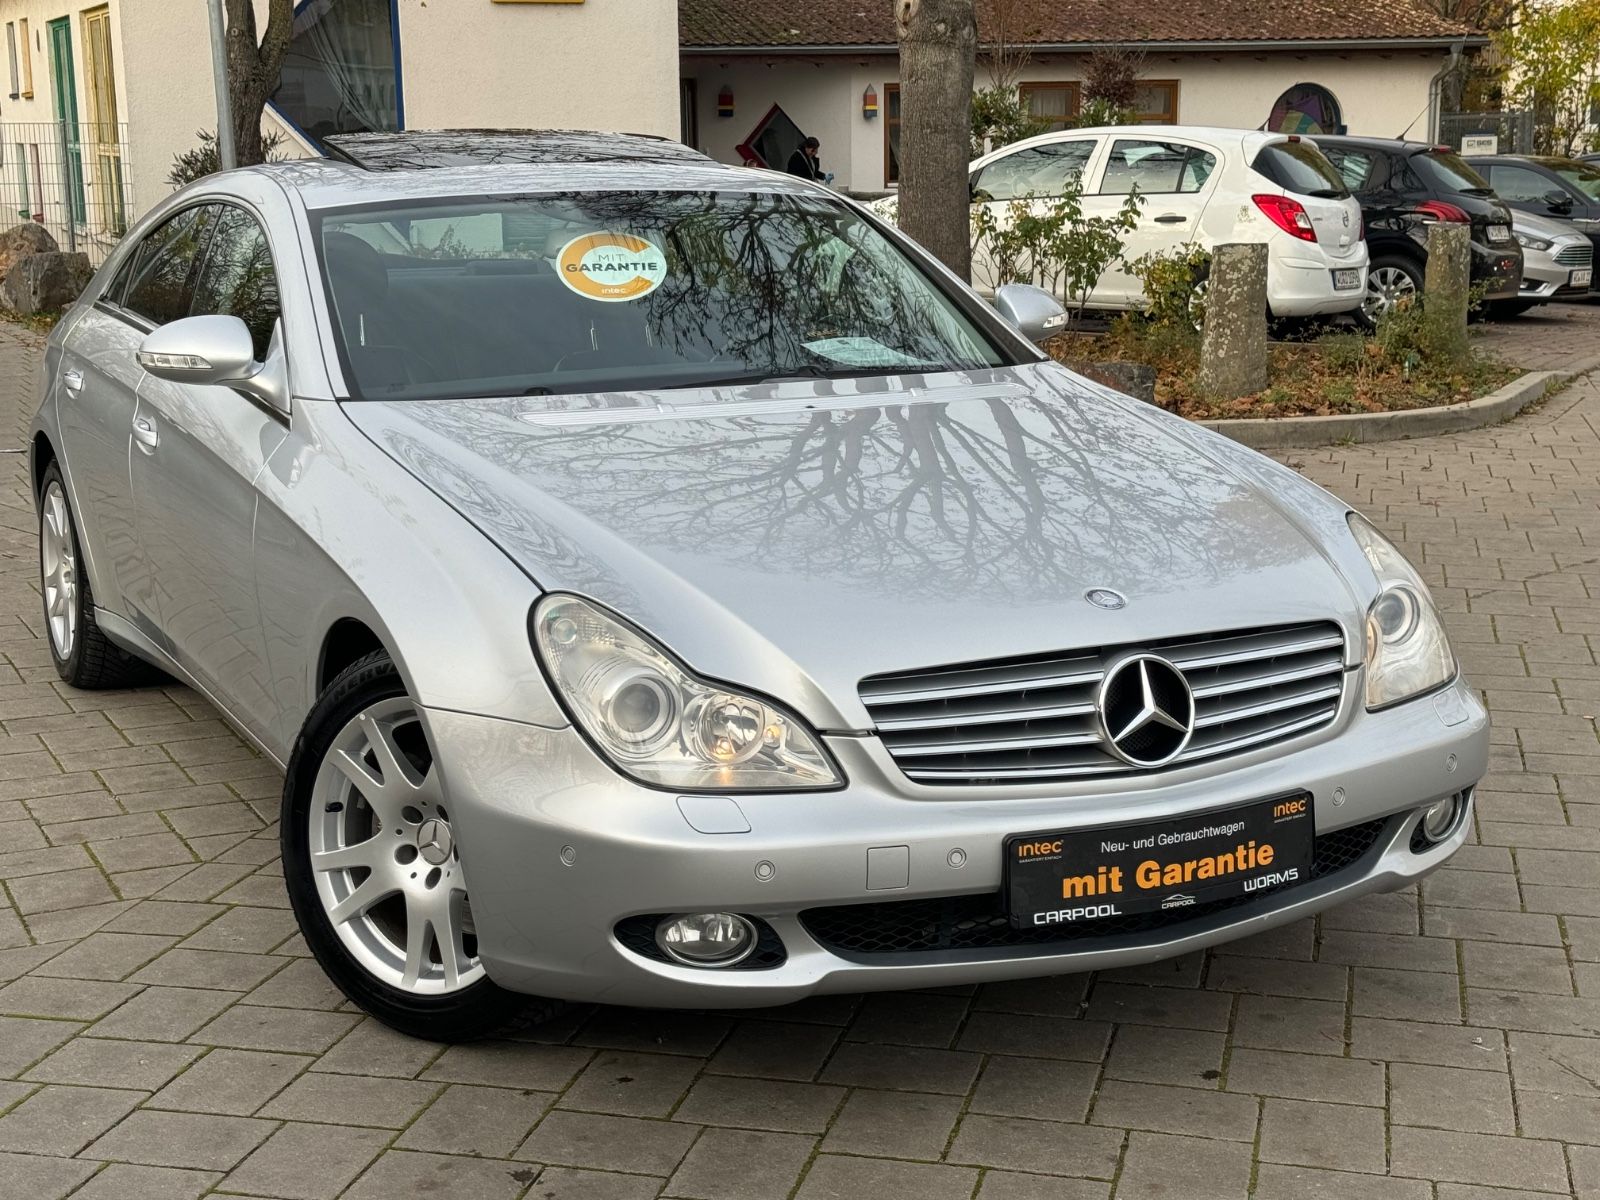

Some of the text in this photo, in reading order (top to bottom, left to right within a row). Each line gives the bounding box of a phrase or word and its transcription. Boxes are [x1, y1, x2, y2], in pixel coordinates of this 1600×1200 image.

[597, 253, 625, 262] MIT
[565, 262, 658, 273] GARANTIE
[601, 286, 628, 295] intec
[1273, 799, 1306, 818] intec
[1101, 821, 1245, 853] Neu- und Gebrauchtwagen
[1018, 840, 1062, 857] intec
[1062, 840, 1274, 899] mit Garantie
[1243, 867, 1299, 892] WORMS
[1161, 898, 1196, 910] CARPOOL
[1033, 903, 1122, 925] CARPOOL
